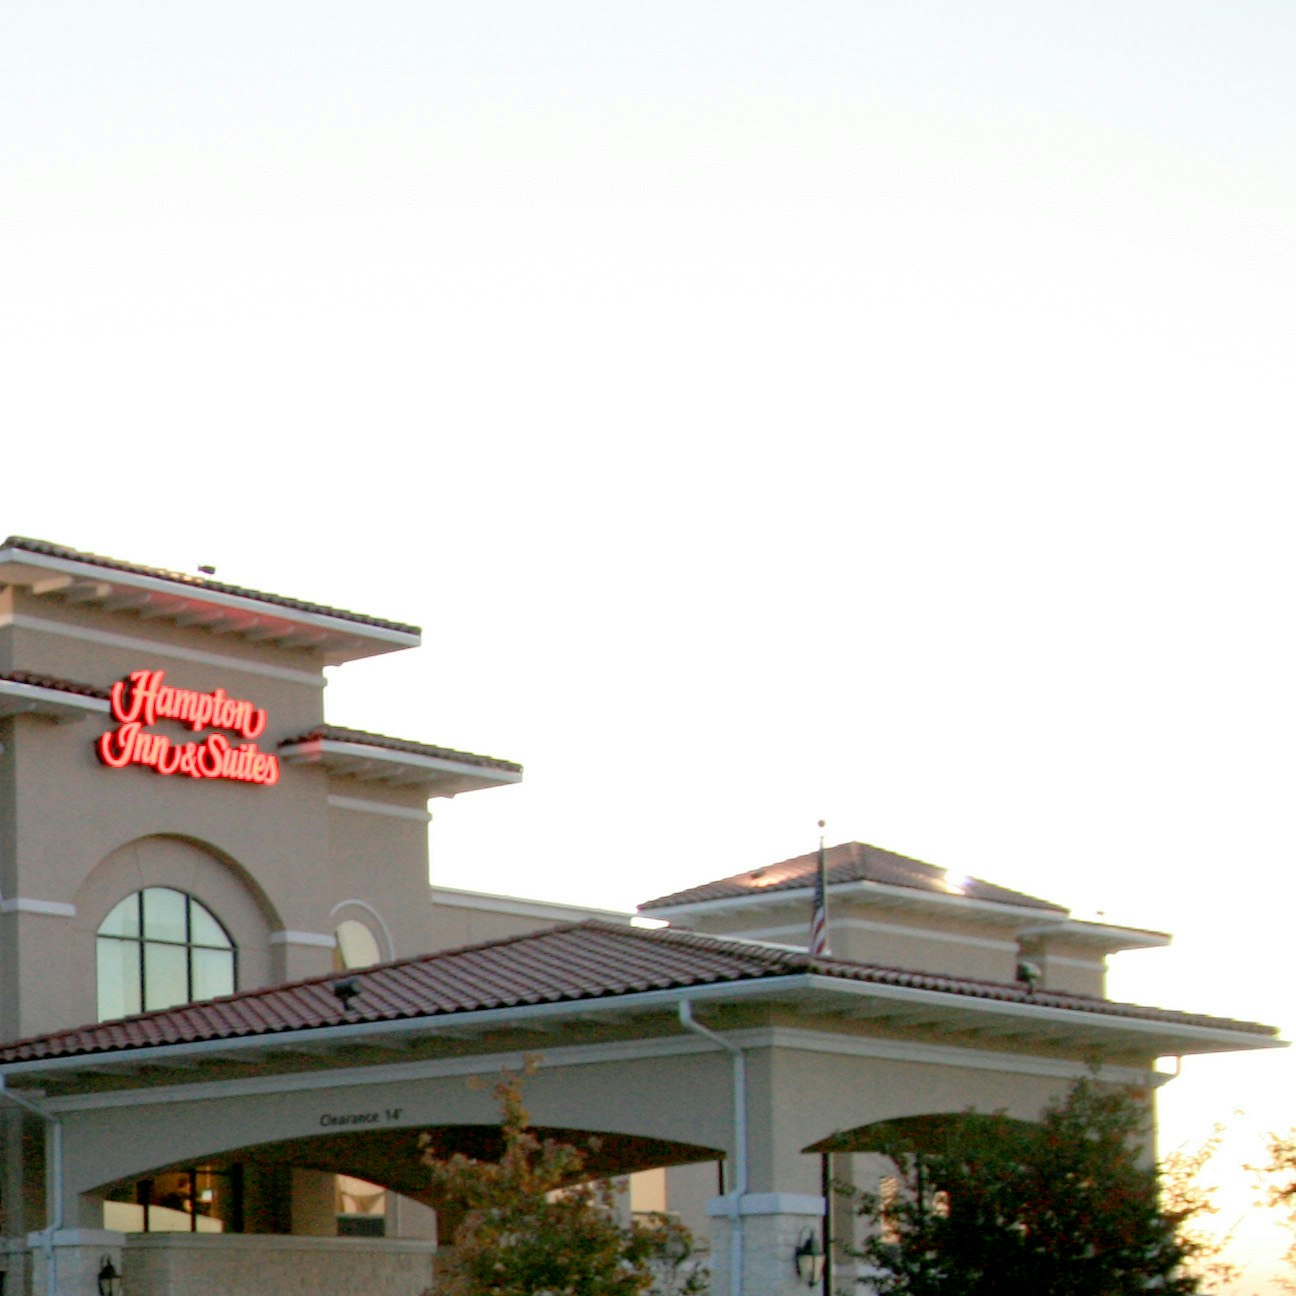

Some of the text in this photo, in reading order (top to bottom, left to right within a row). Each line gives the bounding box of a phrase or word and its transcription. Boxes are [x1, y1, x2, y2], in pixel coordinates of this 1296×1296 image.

[111, 670, 268, 739] Hampton
[100, 722, 280, 785] Inn & Suites
[319, 1113, 380, 1127] Clearance
